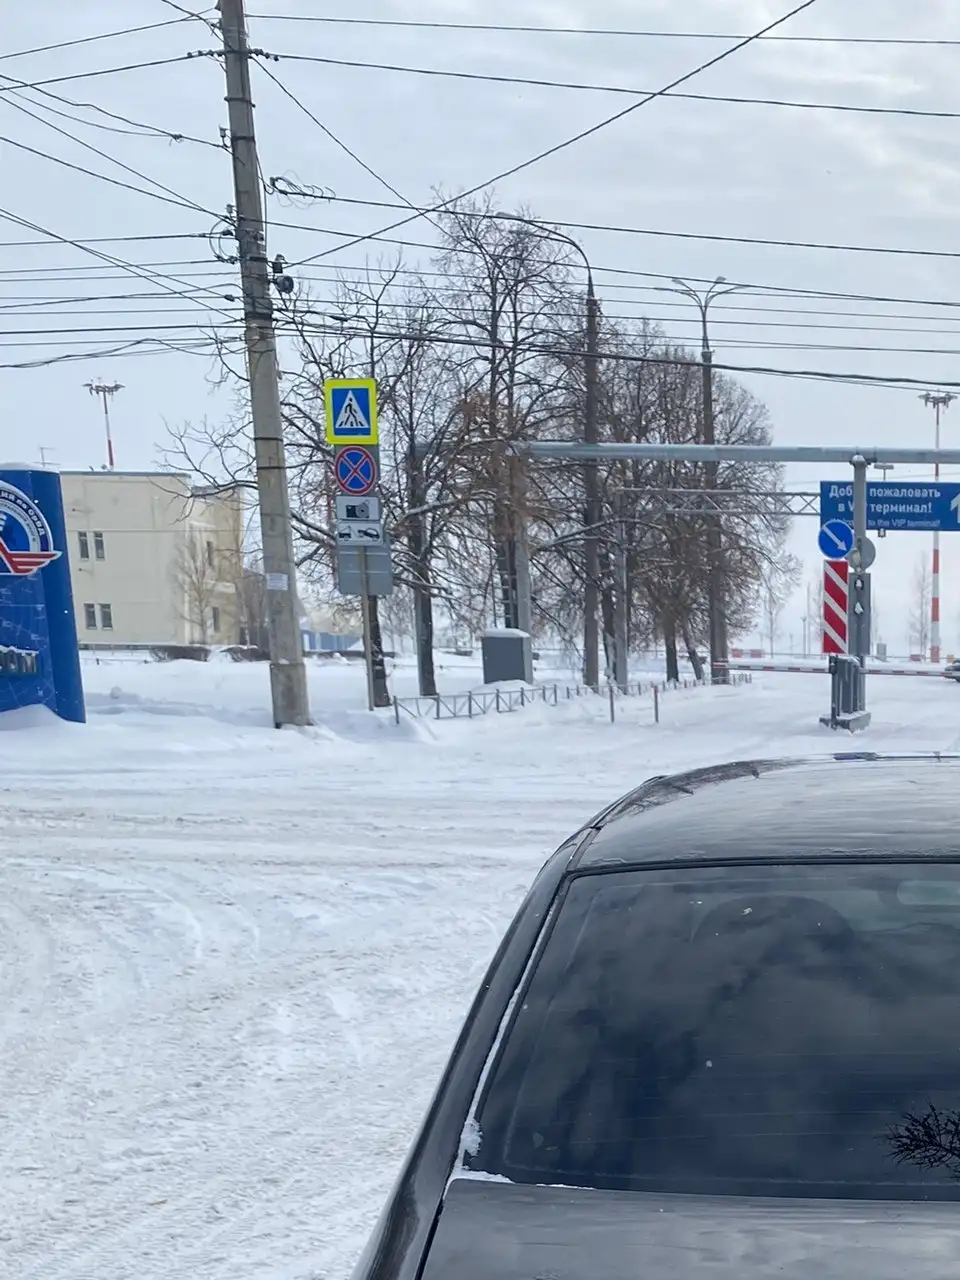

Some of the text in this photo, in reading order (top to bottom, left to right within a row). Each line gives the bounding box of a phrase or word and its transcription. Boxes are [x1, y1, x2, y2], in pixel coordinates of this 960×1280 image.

[829, 485, 941, 498] Доб пожаловать
[870, 502, 932, 515] терминал!
